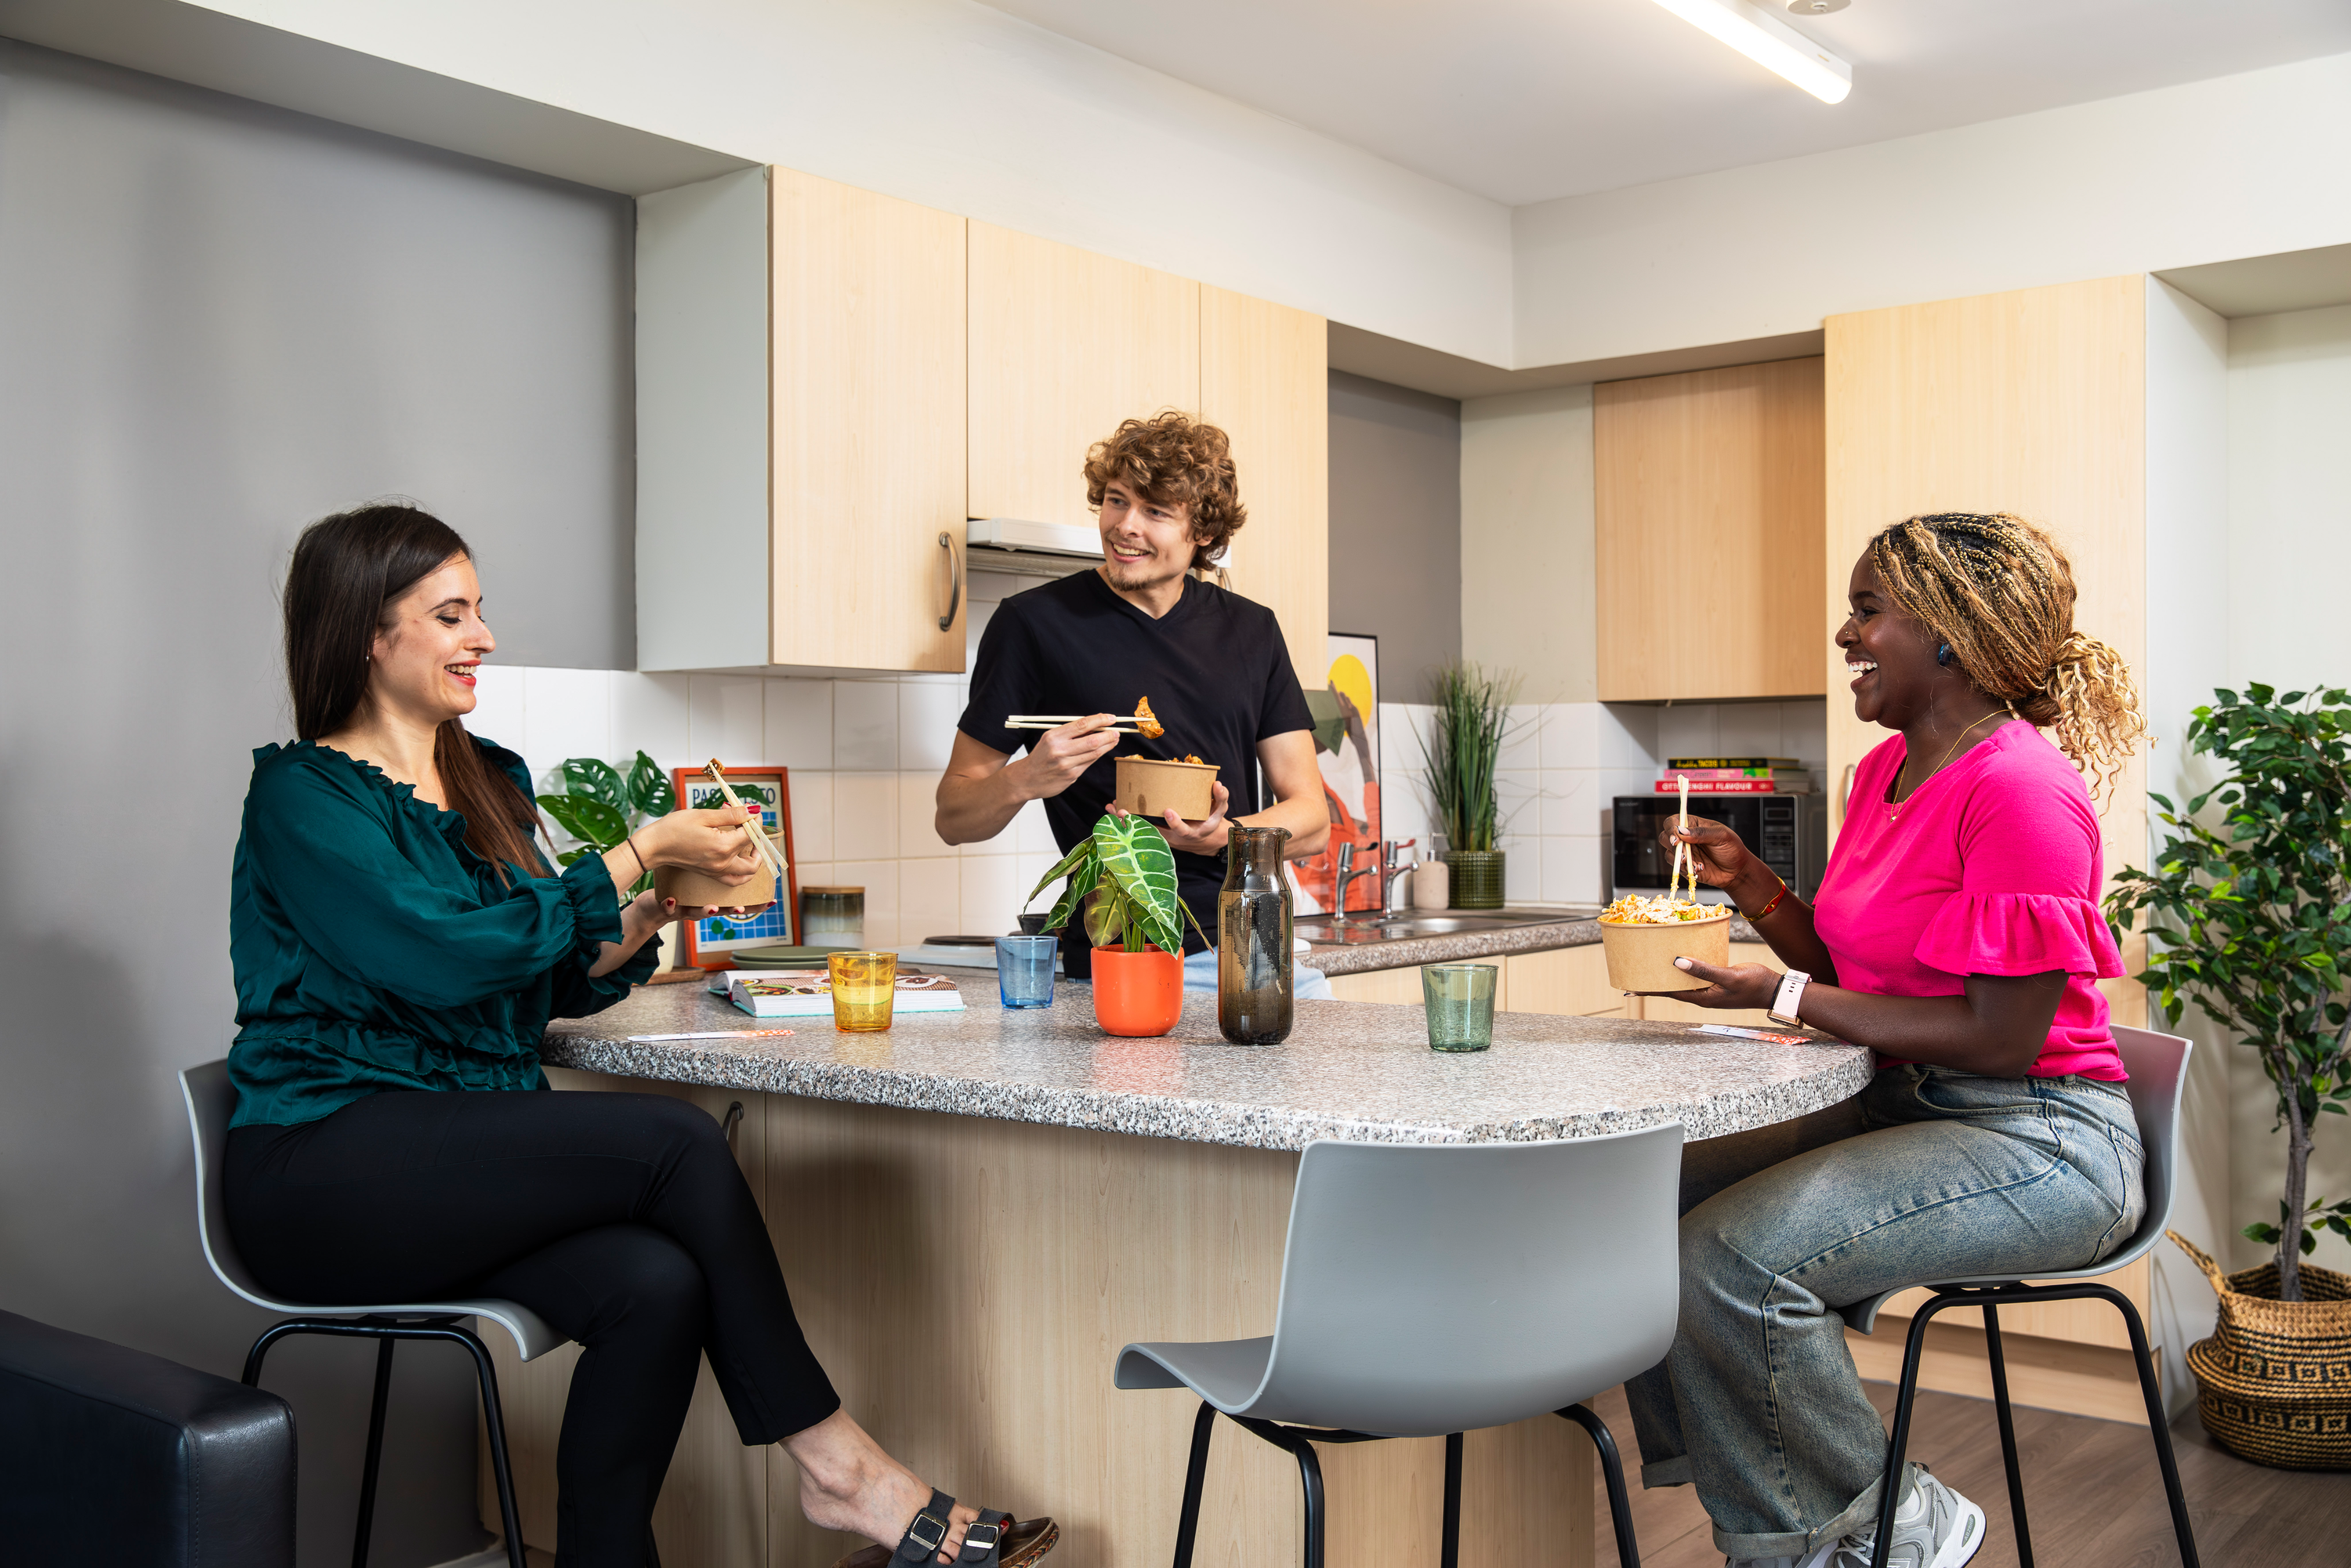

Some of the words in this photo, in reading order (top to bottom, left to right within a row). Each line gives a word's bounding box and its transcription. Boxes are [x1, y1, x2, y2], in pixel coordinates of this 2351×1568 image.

[1697, 759, 1719, 768] TACOS
[1661, 782, 1714, 791] OTTENGHI
[1715, 782, 1753, 791] FLAVOUR
